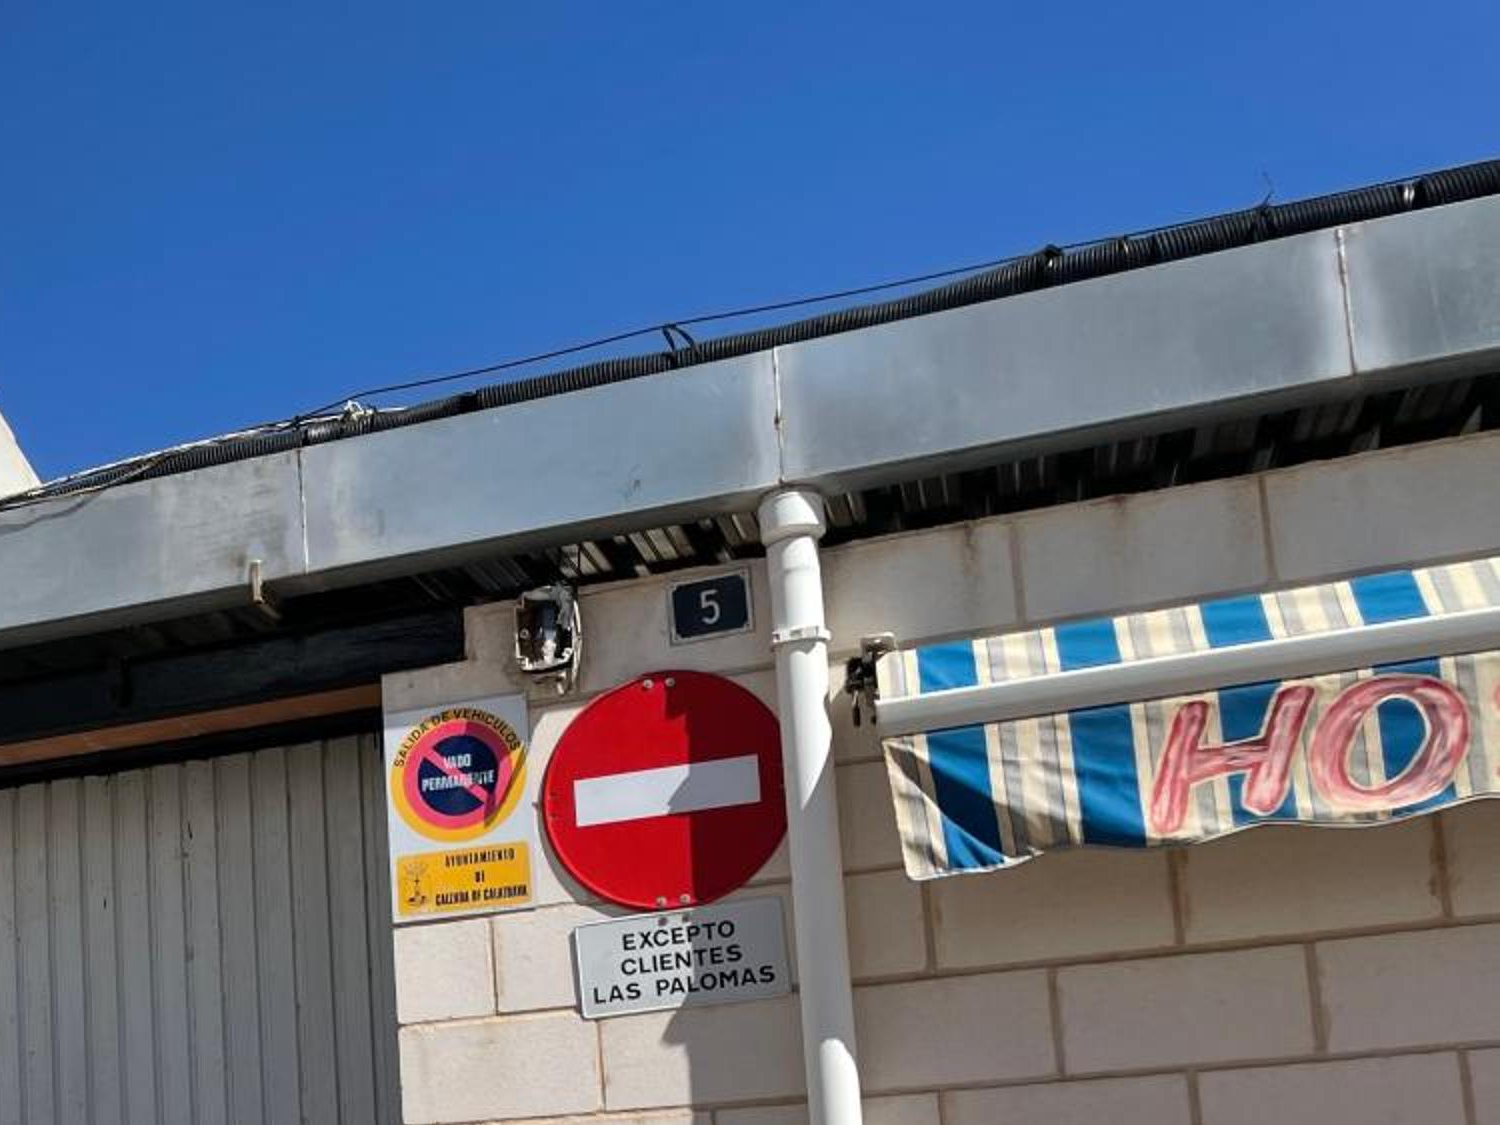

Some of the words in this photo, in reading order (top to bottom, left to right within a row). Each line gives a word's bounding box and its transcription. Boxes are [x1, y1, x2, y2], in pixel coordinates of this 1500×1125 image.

[700, 589, 720, 625] 5
[393, 720, 429, 768] SALIDA
[431, 710, 450, 727] DE
[1150, 673, 1500, 836] HO
[443, 753, 472, 769] VADO
[421, 769, 496, 792] PERMANENTE
[622, 920, 735, 951] EXCEPTO
[620, 944, 743, 976] CLIENTES
[593, 983, 642, 1005] LAS
[655, 965, 776, 997] PALOMAS
